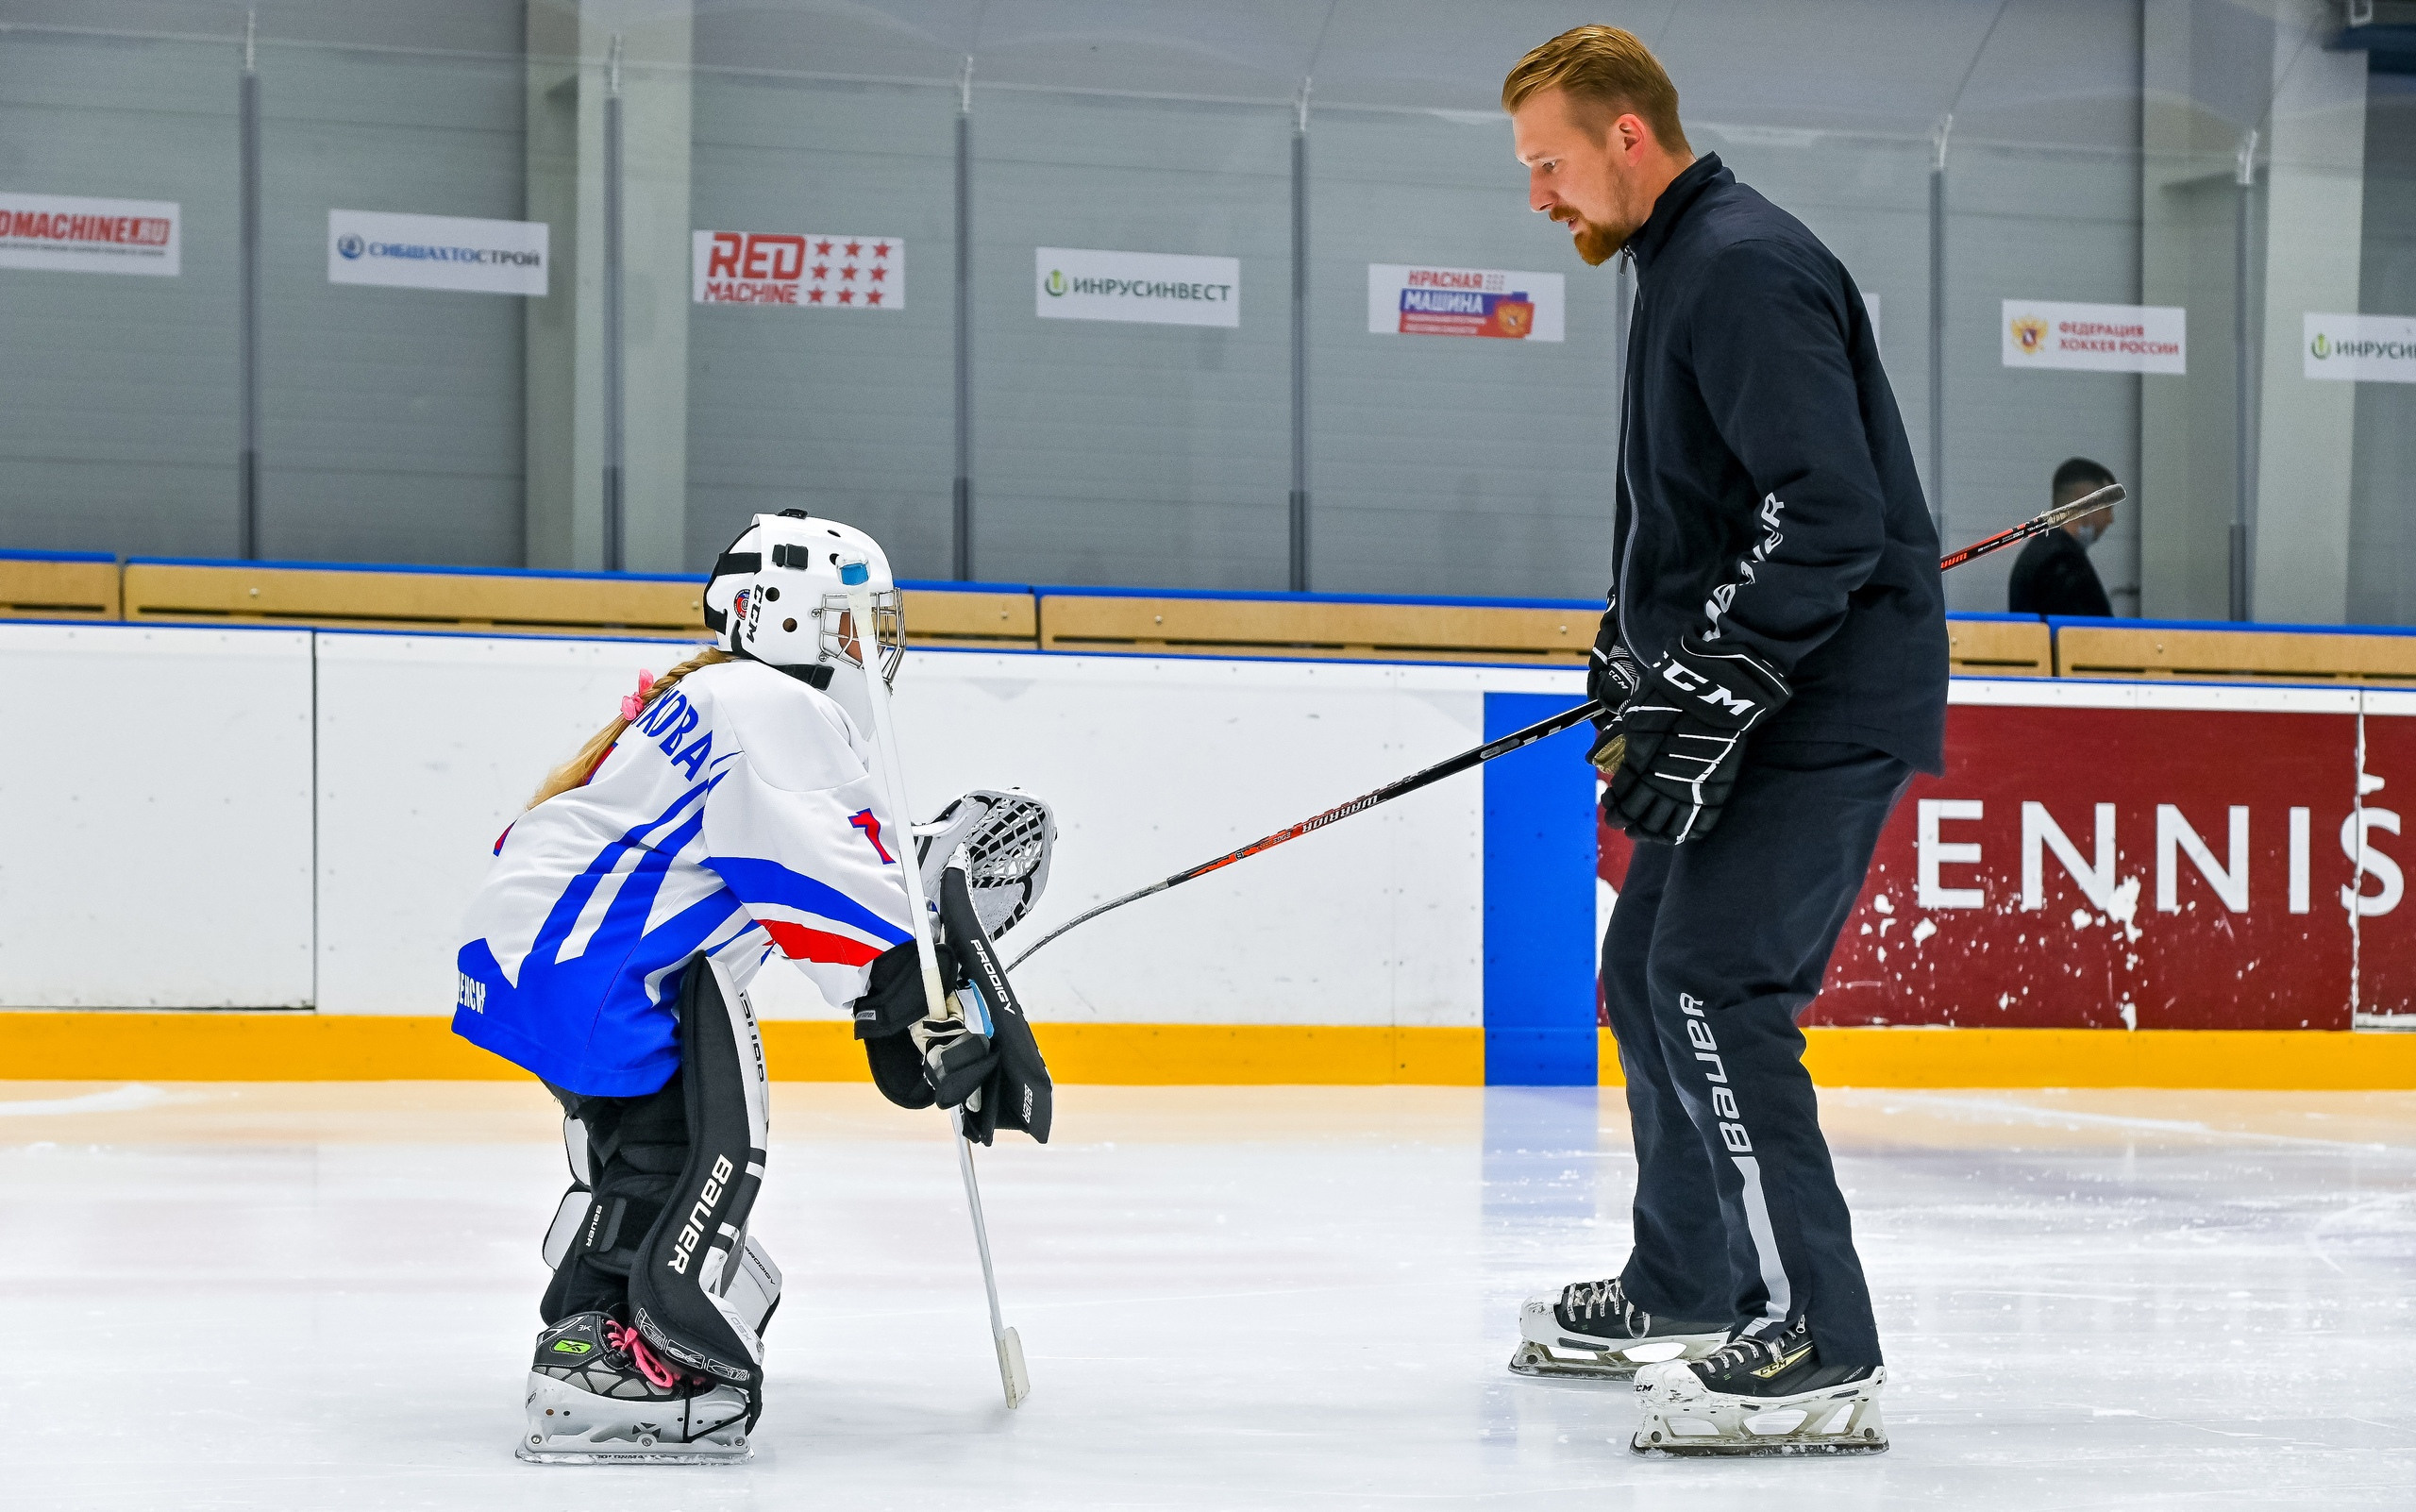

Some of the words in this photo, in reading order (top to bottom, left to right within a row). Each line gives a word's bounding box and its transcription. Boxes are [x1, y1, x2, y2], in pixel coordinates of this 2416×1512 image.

[368, 242, 541, 266] СИБШАХТОСТРОЙ
[708, 232, 806, 280] RED
[1073, 277, 1231, 301] ИНРУСИНВЕСТ
[1408, 270, 1484, 288] КРАСНАЯ
[704, 281, 799, 304] MACHINE
[1403, 291, 1485, 314] МАШИНА
[2336, 340, 2416, 360] ИНРУСИ
[747, 583, 764, 644] CCM
[1608, 669, 1629, 691] CCM
[1653, 649, 1756, 716] CM
[1300, 795, 1379, 833] WARRIOR
[847, 808, 897, 865] 1
[971, 938, 1016, 1016] PRODIGY
[745, 1246, 776, 1285] PRODIGY
[1760, 1360, 1788, 1376] CCM
